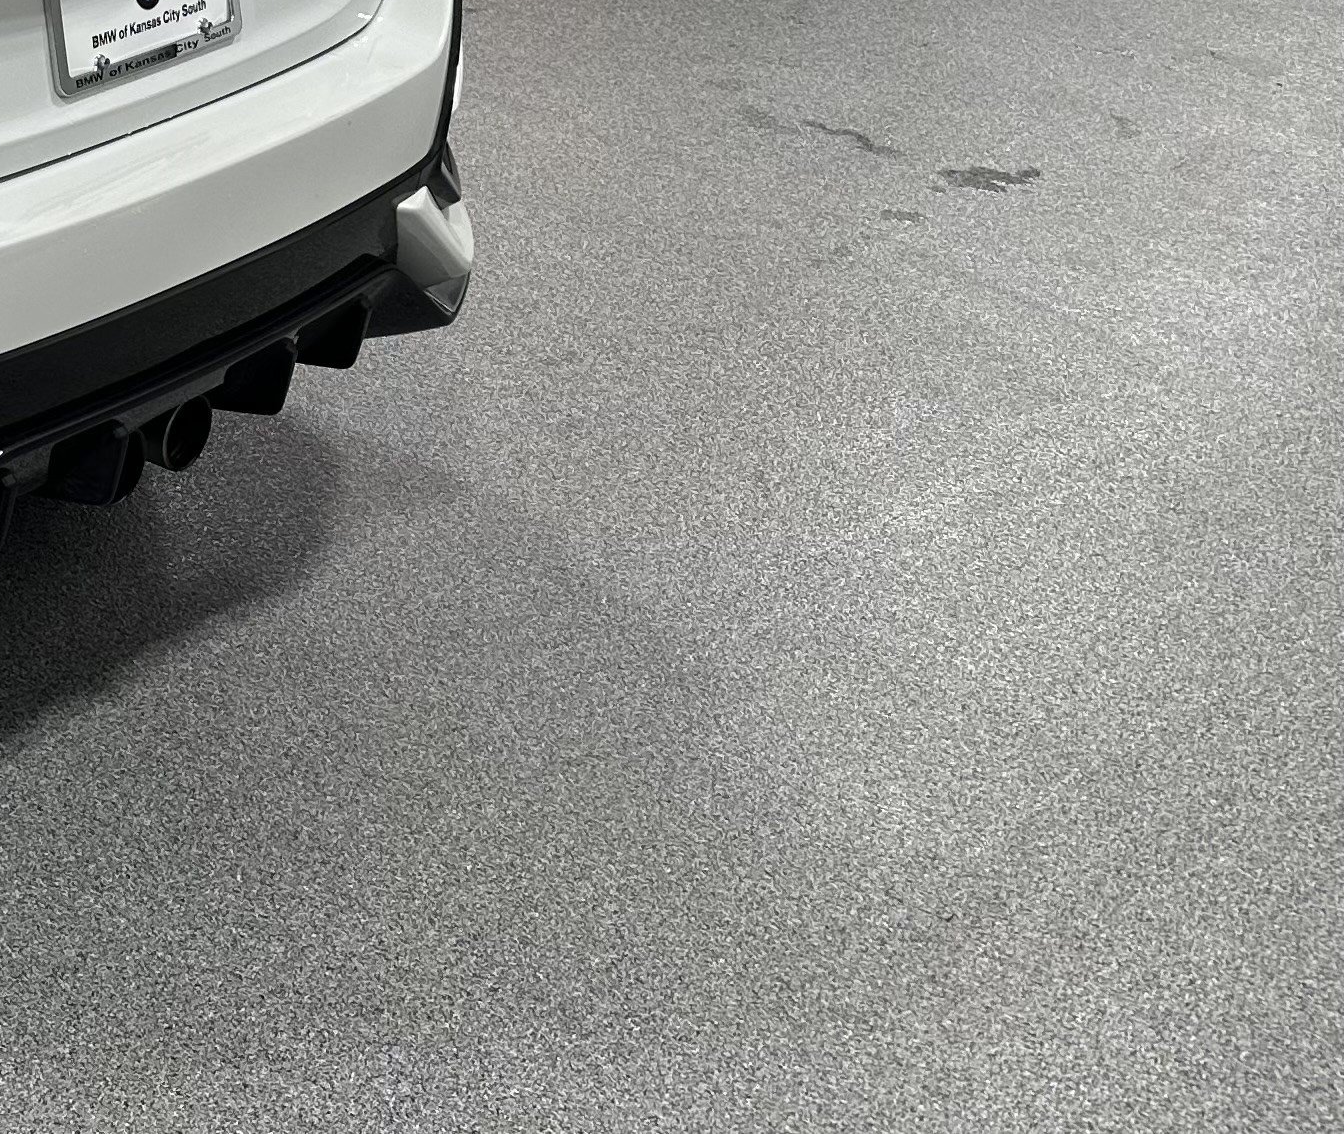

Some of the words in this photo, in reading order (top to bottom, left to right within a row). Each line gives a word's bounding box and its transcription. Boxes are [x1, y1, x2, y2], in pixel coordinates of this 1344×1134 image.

[92, 28, 117, 49] BMW
[119, 24, 129, 40] of
[129, 17, 162, 37] Kansas
[163, 8, 181, 24] City
[75, 69, 104, 89] BMW
[109, 63, 123, 77] of
[125, 48, 173, 72] Kansas
[175, 38, 200, 54] City
[203, 26, 232, 43] South
